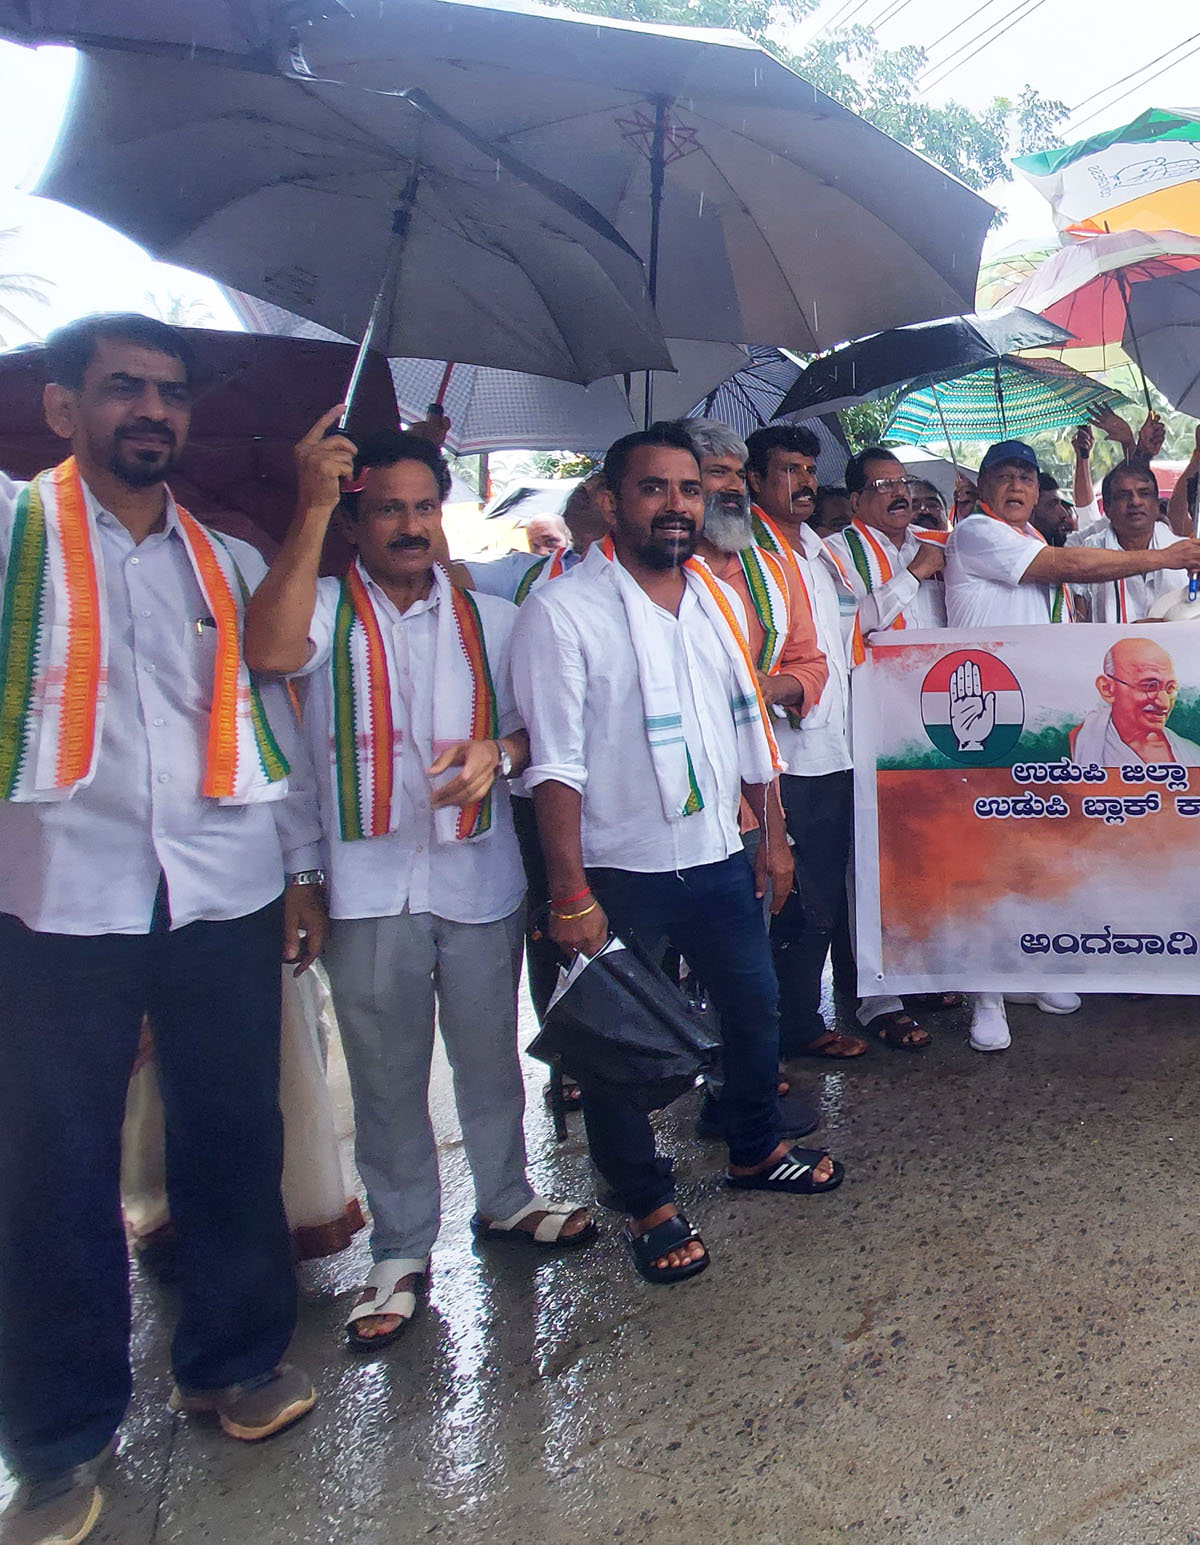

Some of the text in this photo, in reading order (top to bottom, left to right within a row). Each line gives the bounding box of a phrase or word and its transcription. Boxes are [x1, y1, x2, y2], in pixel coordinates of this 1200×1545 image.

[1012, 758, 1106, 782] ಉಡುಪಿ
[1121, 764, 1188, 790] ಜಿಲ್ಲಾ
[975, 793, 1068, 817] ಉಡುಪಿ
[1084, 793, 1159, 824] ಬ್ಲಾಕ್
[1020, 925, 1198, 955] ಅಂಗವಾಗಿ
